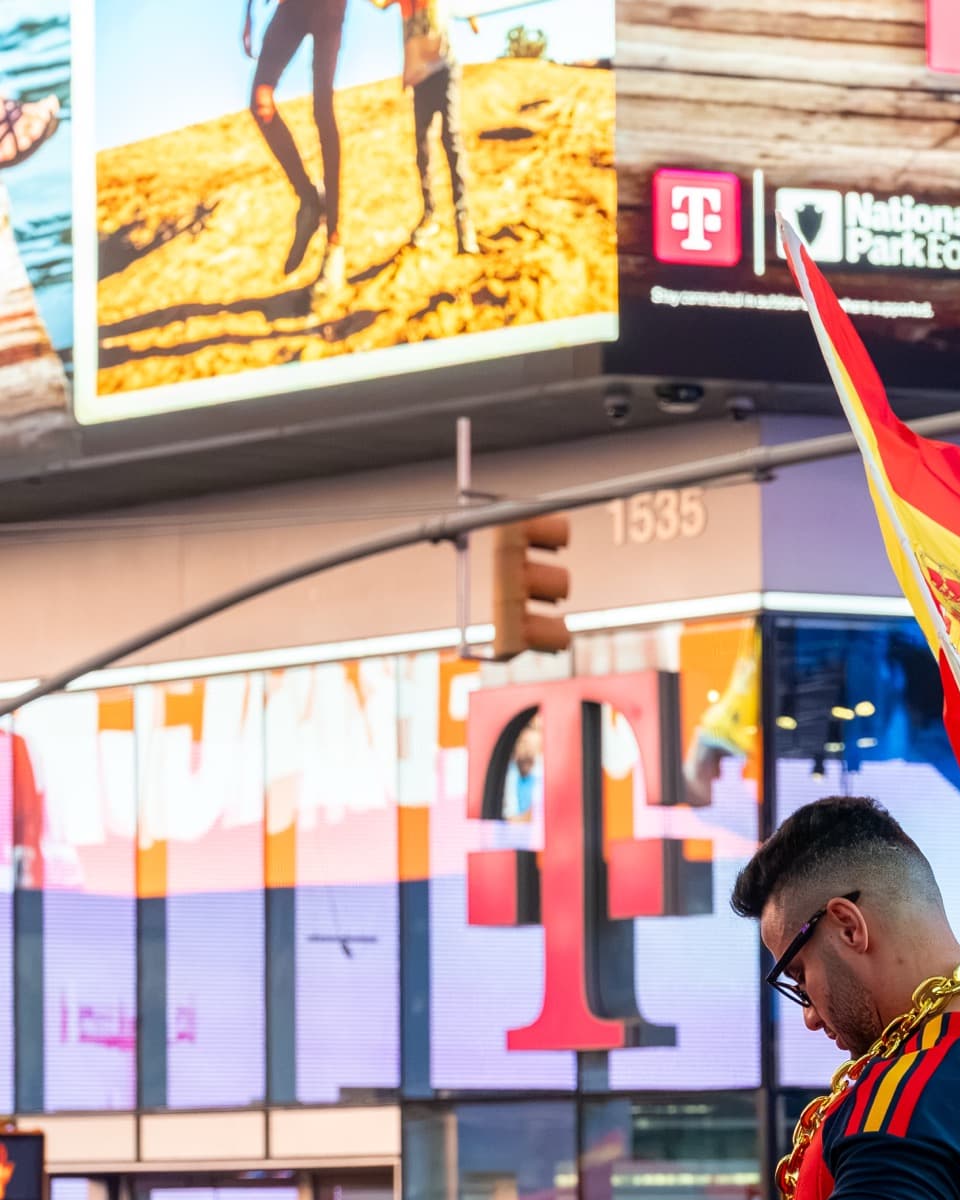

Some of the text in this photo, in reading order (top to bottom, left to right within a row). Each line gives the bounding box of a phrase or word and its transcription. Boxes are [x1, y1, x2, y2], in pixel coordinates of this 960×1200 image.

[671, 186, 721, 251] T
[846, 229, 927, 267] Park
[606, 487, 709, 546] 1535
[468, 668, 704, 1050] T
